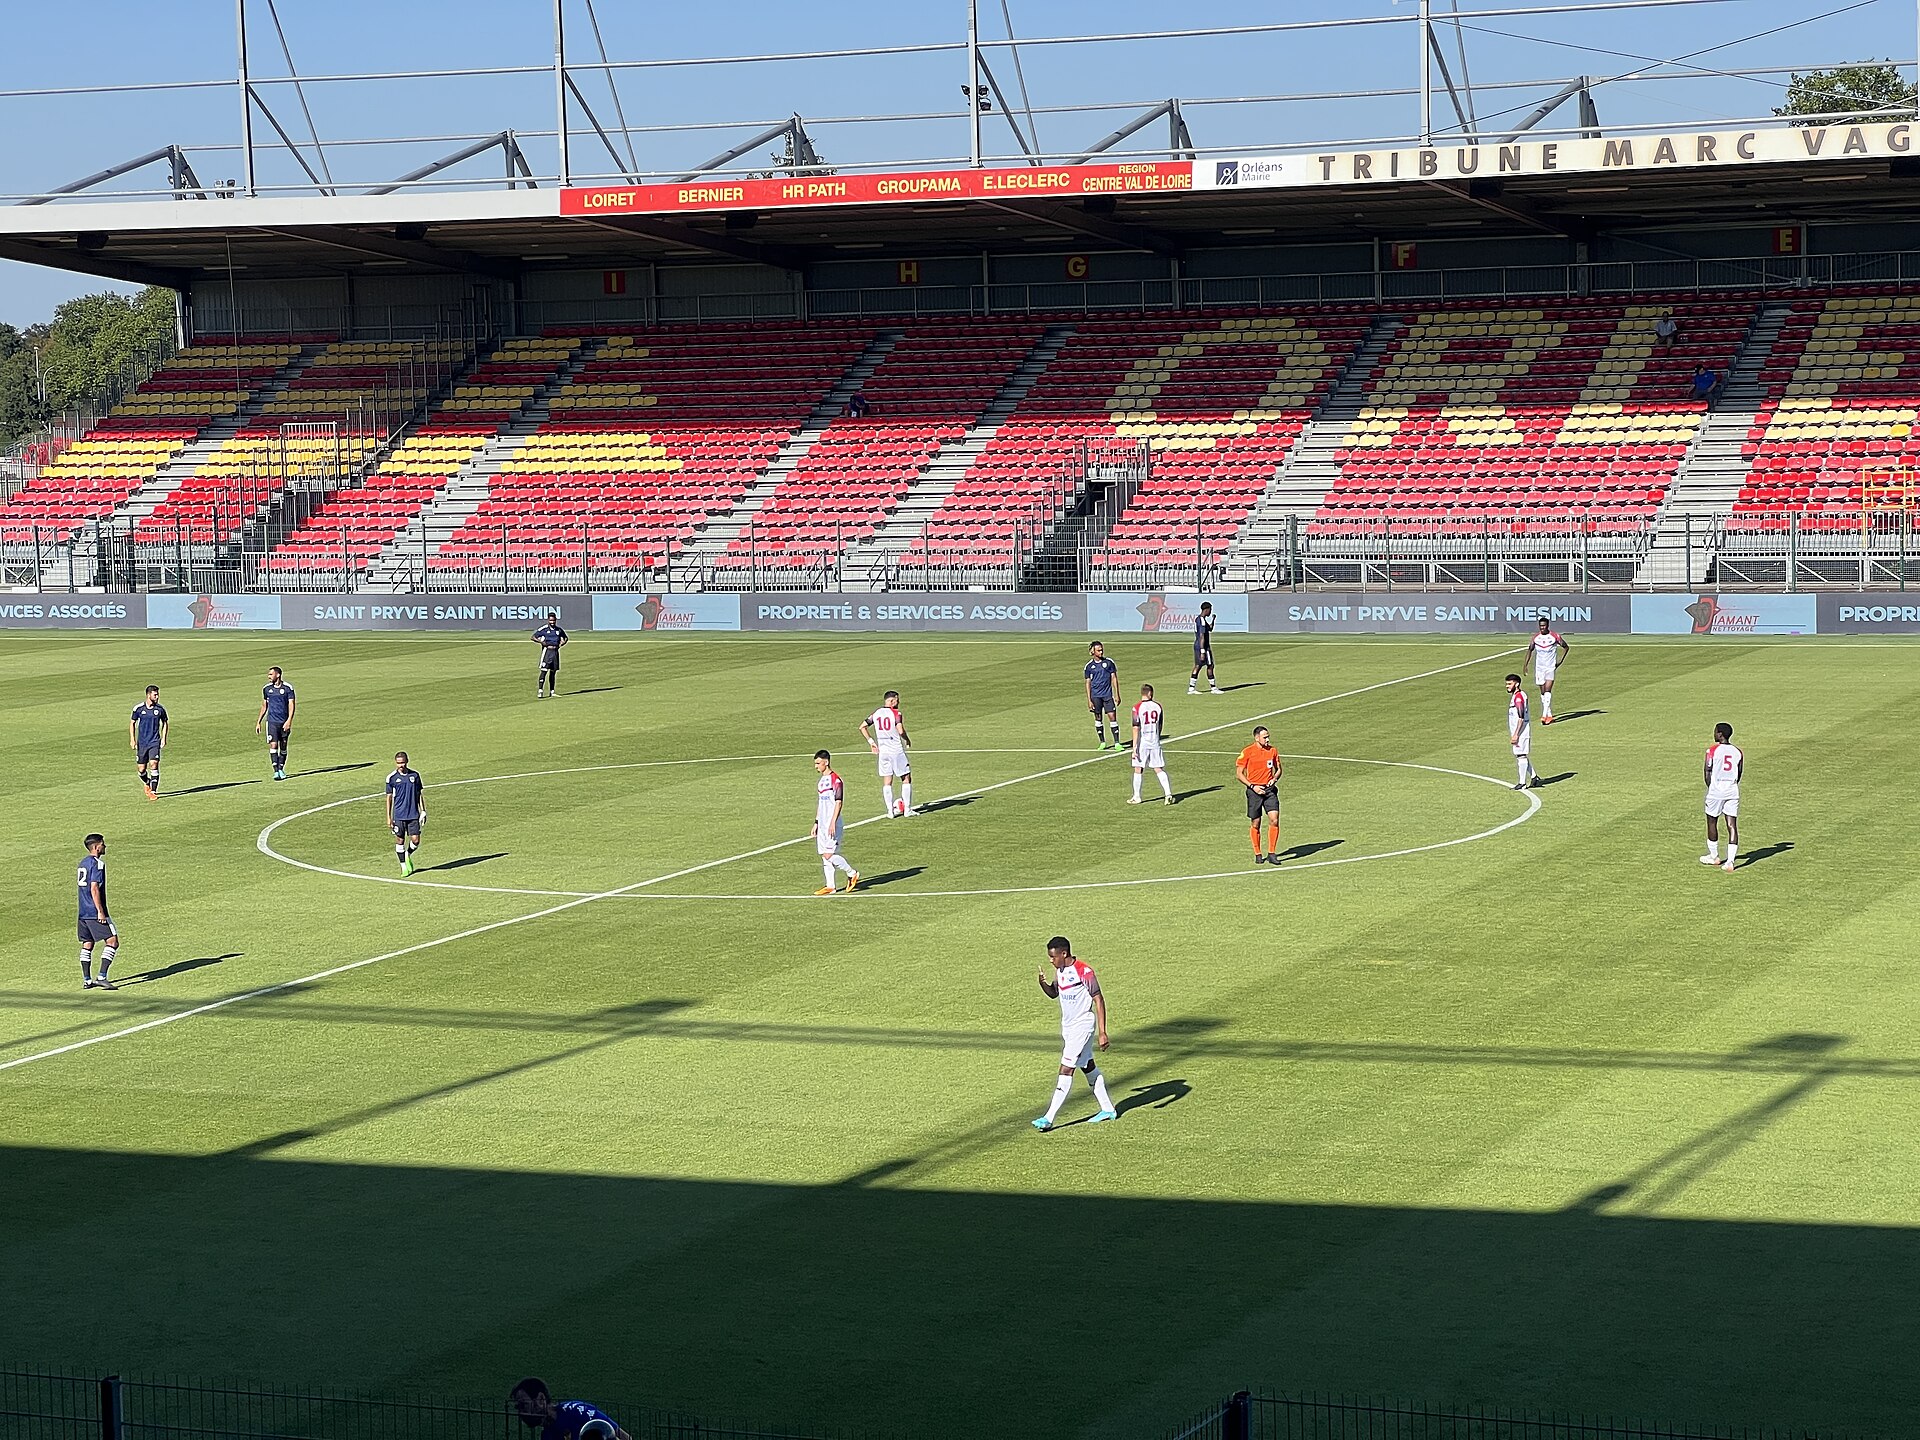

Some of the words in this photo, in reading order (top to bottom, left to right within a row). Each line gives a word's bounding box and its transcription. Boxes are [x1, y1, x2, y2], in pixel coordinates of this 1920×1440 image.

[1318, 143, 1558, 181] TRIBUNE
[1602, 132, 1755, 167] MARC
[1801, 125, 1910, 155] VAG
[1119, 164, 1156, 174] REGION
[1241, 162, 1283, 173] Orléans
[983, 172, 1071, 190] E.LECLERC
[1082, 176, 1123, 192] CENTRE
[1125, 175, 1144, 190] VAL
[1146, 175, 1160, 189] DE
[1162, 174, 1191, 188] LOIRE
[1241, 173, 1271, 181] Mairie
[782, 185, 804, 199] HR
[808, 183, 846, 197] PATH
[877, 178, 961, 194] GROUPAMA
[584, 192, 636, 208] LOIRET
[678, 187, 744, 204] BERNIER
[1779, 229, 1793, 252] E
[1398, 246, 1410, 267] F
[900, 263, 918, 283] H
[1067, 256, 1086, 277] G
[48, 601, 127, 618] ASSOCIÉS
[313, 605, 366, 620] SAINT
[371, 605, 428, 620] PRYVE
[433, 605, 486, 620] SAINT
[491, 605, 562, 620] MESMIN
[758, 601, 852, 620] PROPRETÉ
[857, 605, 871, 620] &
[875, 605, 965, 620] SERVICES
[969, 601, 1063, 620] ASSOCIÉS
[1288, 606, 1352, 622] SAINT
[1358, 606, 1427, 622] PRYVE
[1434, 606, 1499, 622] SAINT
[1505, 606, 1592, 622] MESMIN
[876, 716, 891, 731] 10
[1142, 711, 1159, 725] 19
[1723, 755, 1732, 771] 5
